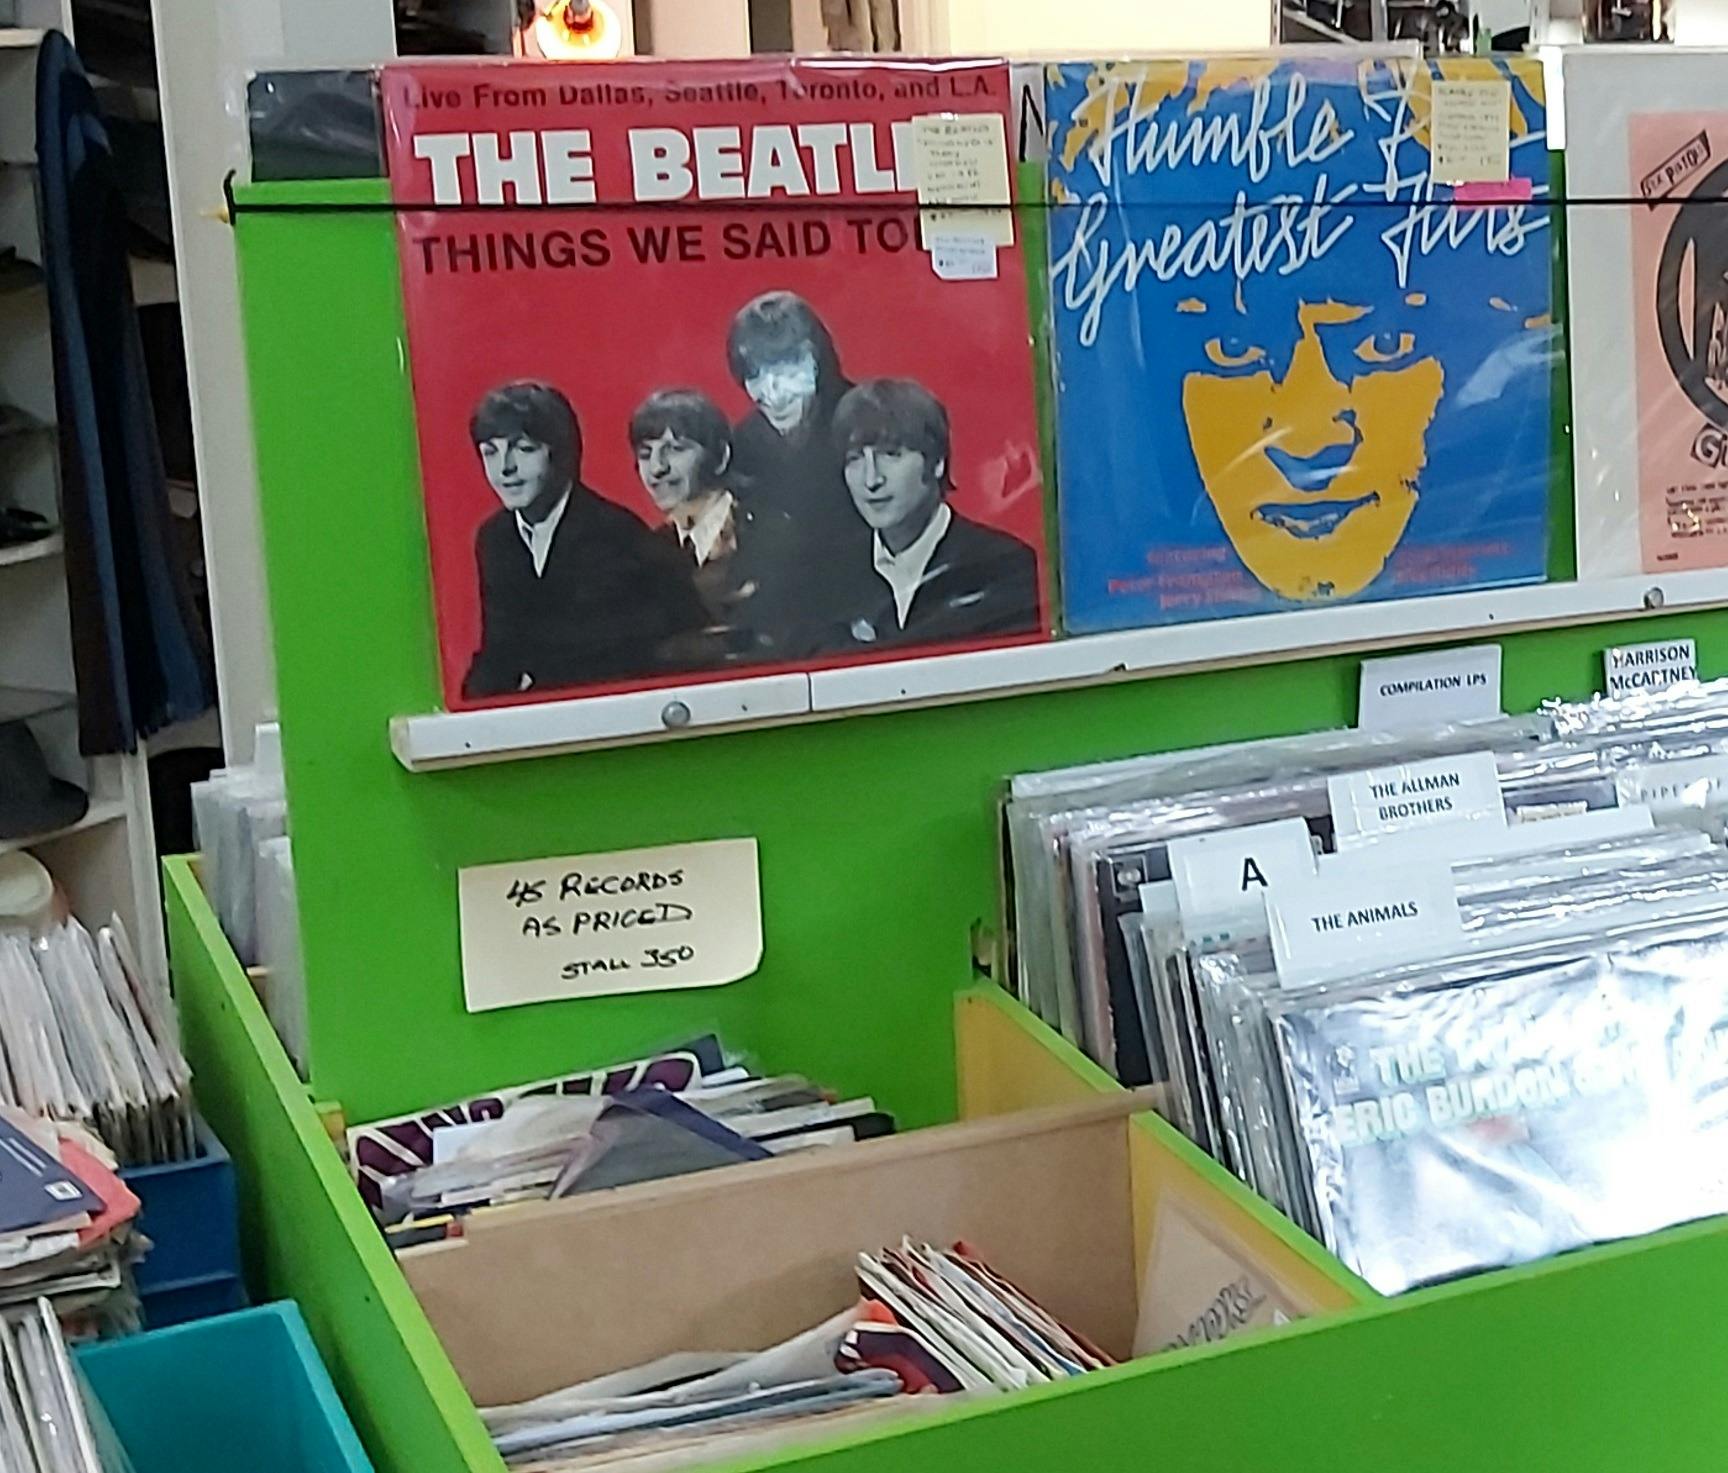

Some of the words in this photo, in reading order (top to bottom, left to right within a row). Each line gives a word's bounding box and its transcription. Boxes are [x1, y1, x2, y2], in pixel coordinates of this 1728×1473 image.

[404, 84, 461, 109] Live
[473, 83, 547, 109] From
[559, 82, 654, 107] Dallas,
[665, 79, 766, 105] Seattle,
[894, 75, 939, 99] and
[950, 74, 996, 96] L.A.
[1071, 72, 1355, 187] Humble
[412, 129, 598, 207] THE
[627, 123, 918, 203] BEATL
[413, 228, 611, 275] THINGS
[627, 223, 706, 264] WE
[723, 217, 831, 261] SAID
[1050, 173, 1358, 347] Greatest
[1379, 674, 1461, 698] COMPILATION
[1466, 672, 1488, 687] LPS
[1370, 781, 1399, 801] THE
[1400, 771, 1461, 795] ALLMAN
[1378, 796, 1454, 822] BROTHERS
[506, 879, 547, 907] 45
[559, 869, 684, 901] RECORDS
[1240, 856, 1269, 892] A
[522, 916, 562, 937] AS
[572, 902, 693, 935] PRICED
[1311, 914, 1345, 933] THE
[1347, 900, 1419, 928] ANIMALS
[560, 958, 631, 980] STALL
[640, 945, 695, 968] 350
[1332, 1093, 1417, 1149] ERIC
